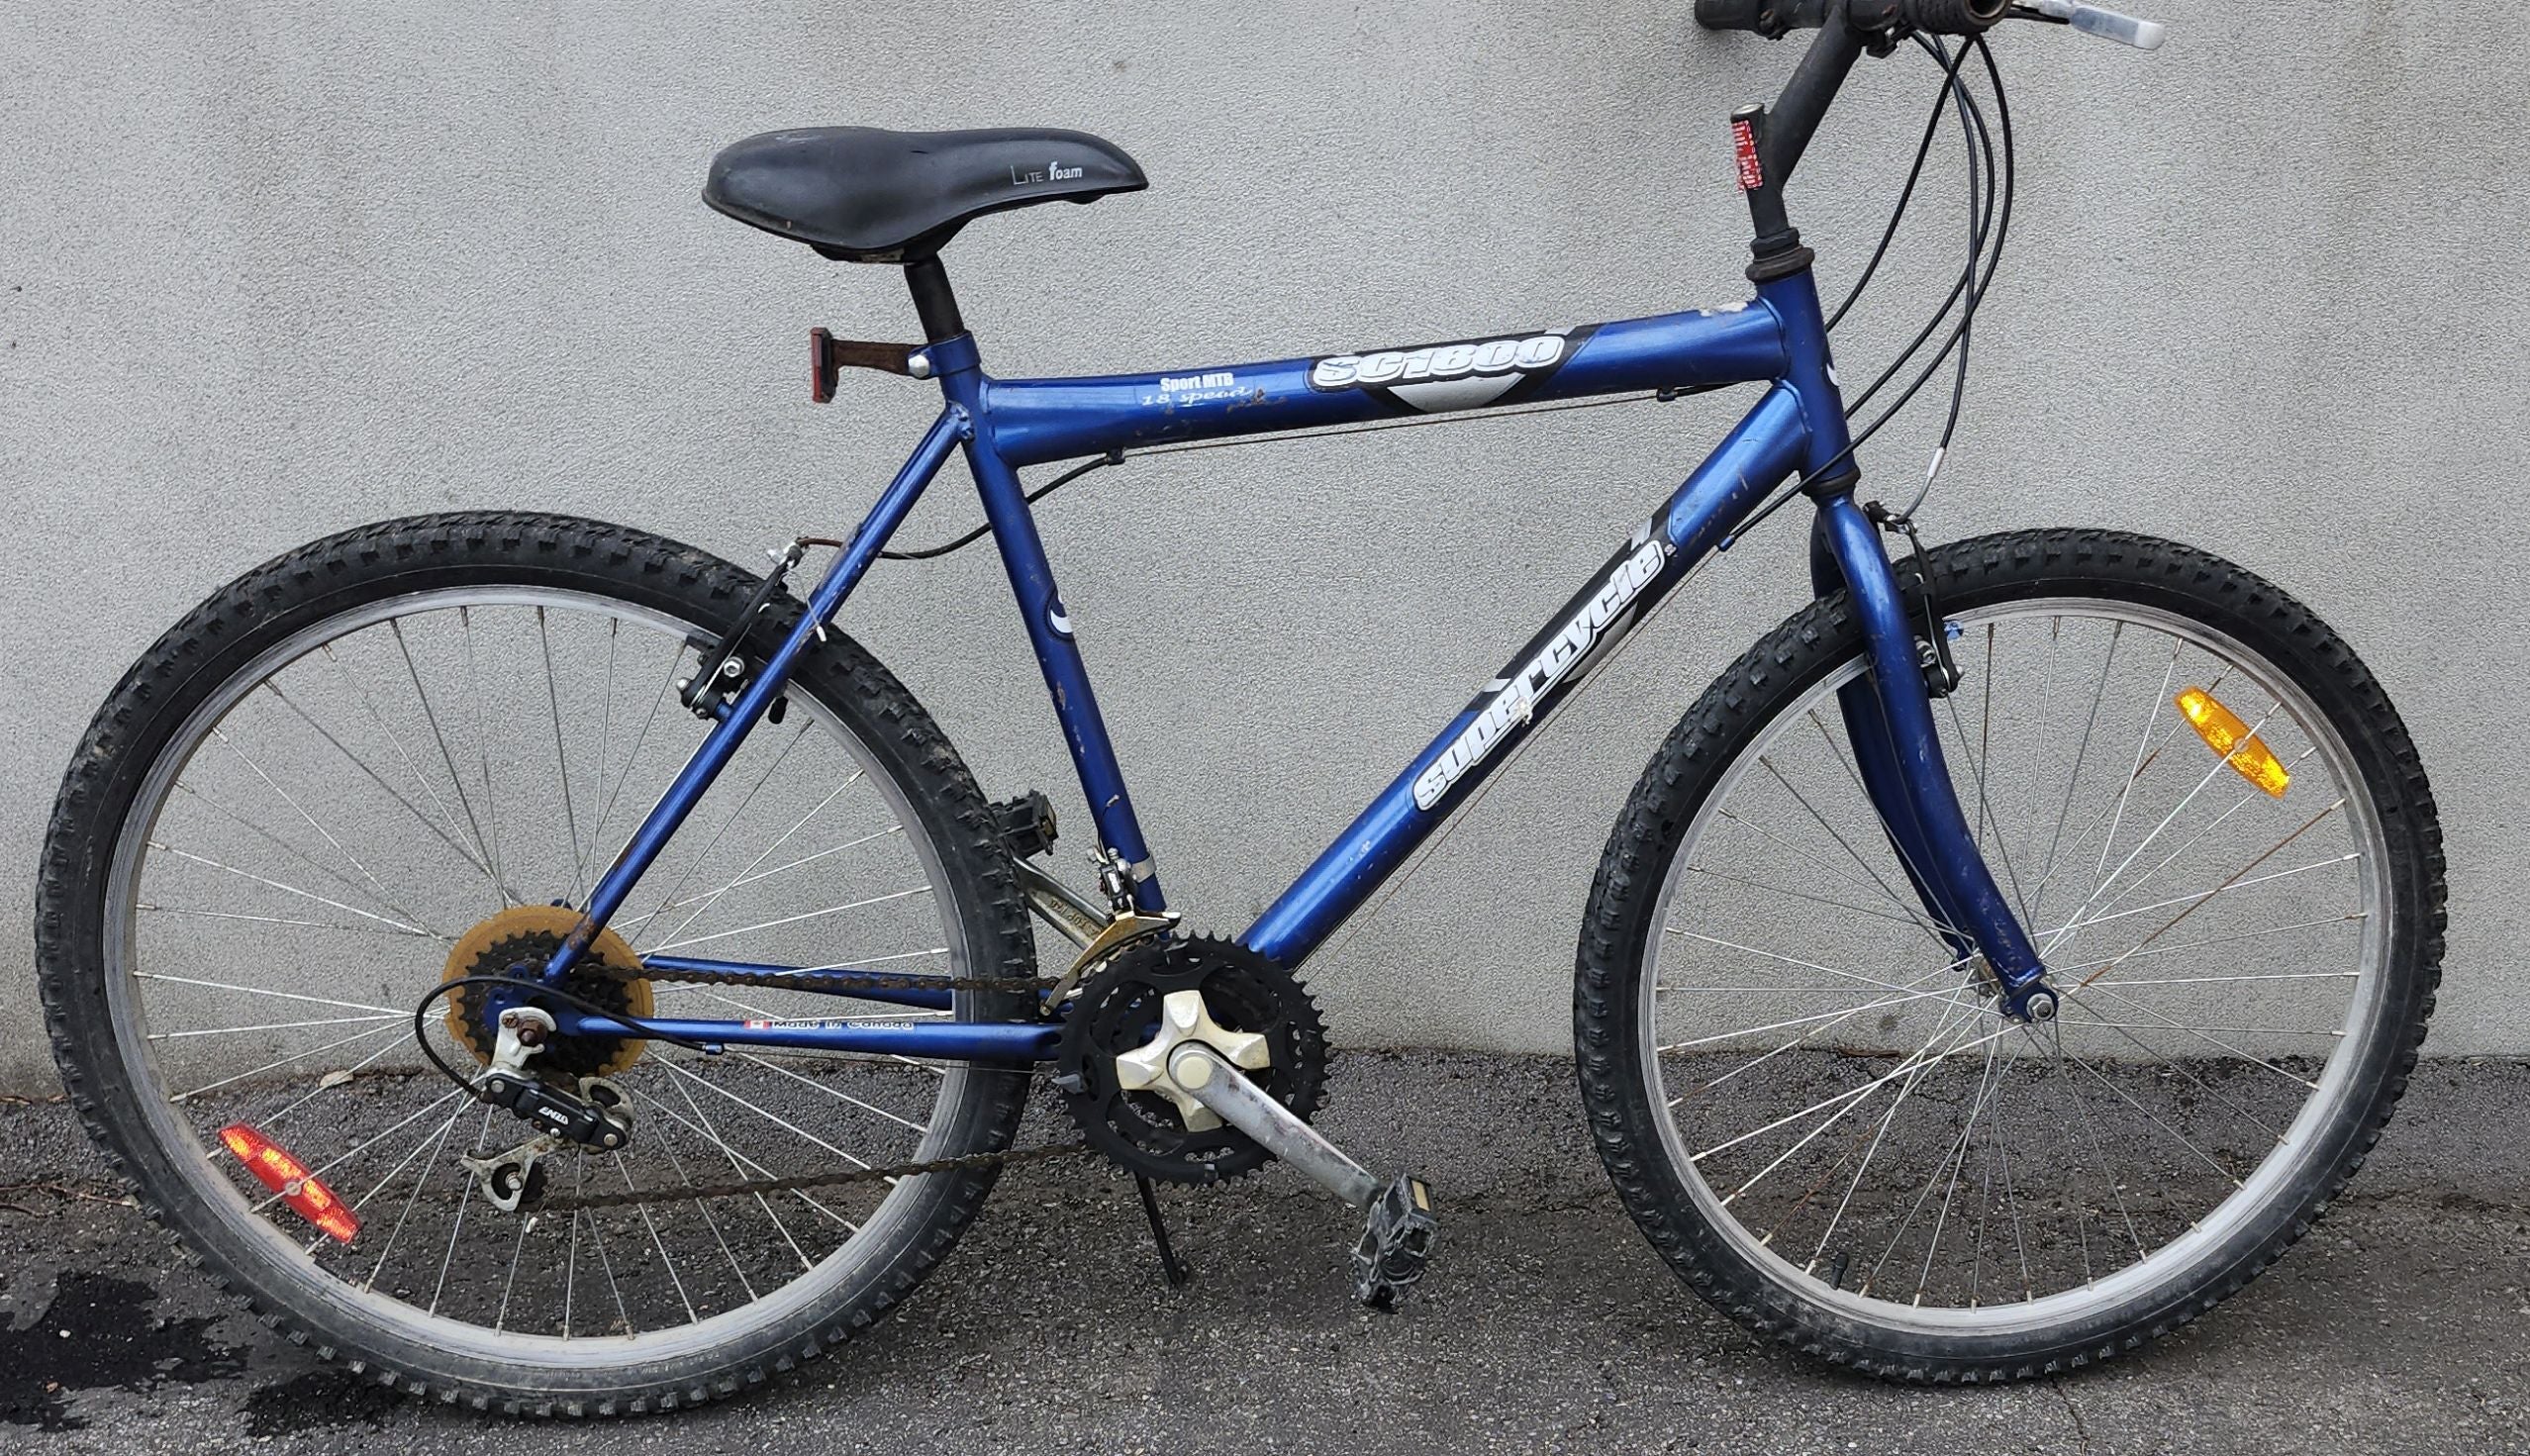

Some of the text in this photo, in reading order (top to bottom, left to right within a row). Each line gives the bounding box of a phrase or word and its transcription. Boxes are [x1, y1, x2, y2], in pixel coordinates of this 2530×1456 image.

[1048, 161, 1083, 181] foam
[1313, 336, 1566, 387] SC1800
[1160, 372, 1234, 393] Sport MTB
[1141, 386, 1253, 406] 18 speed
[771, 1019, 821, 1029] Made
[846, 1020, 915, 1030] Canada
